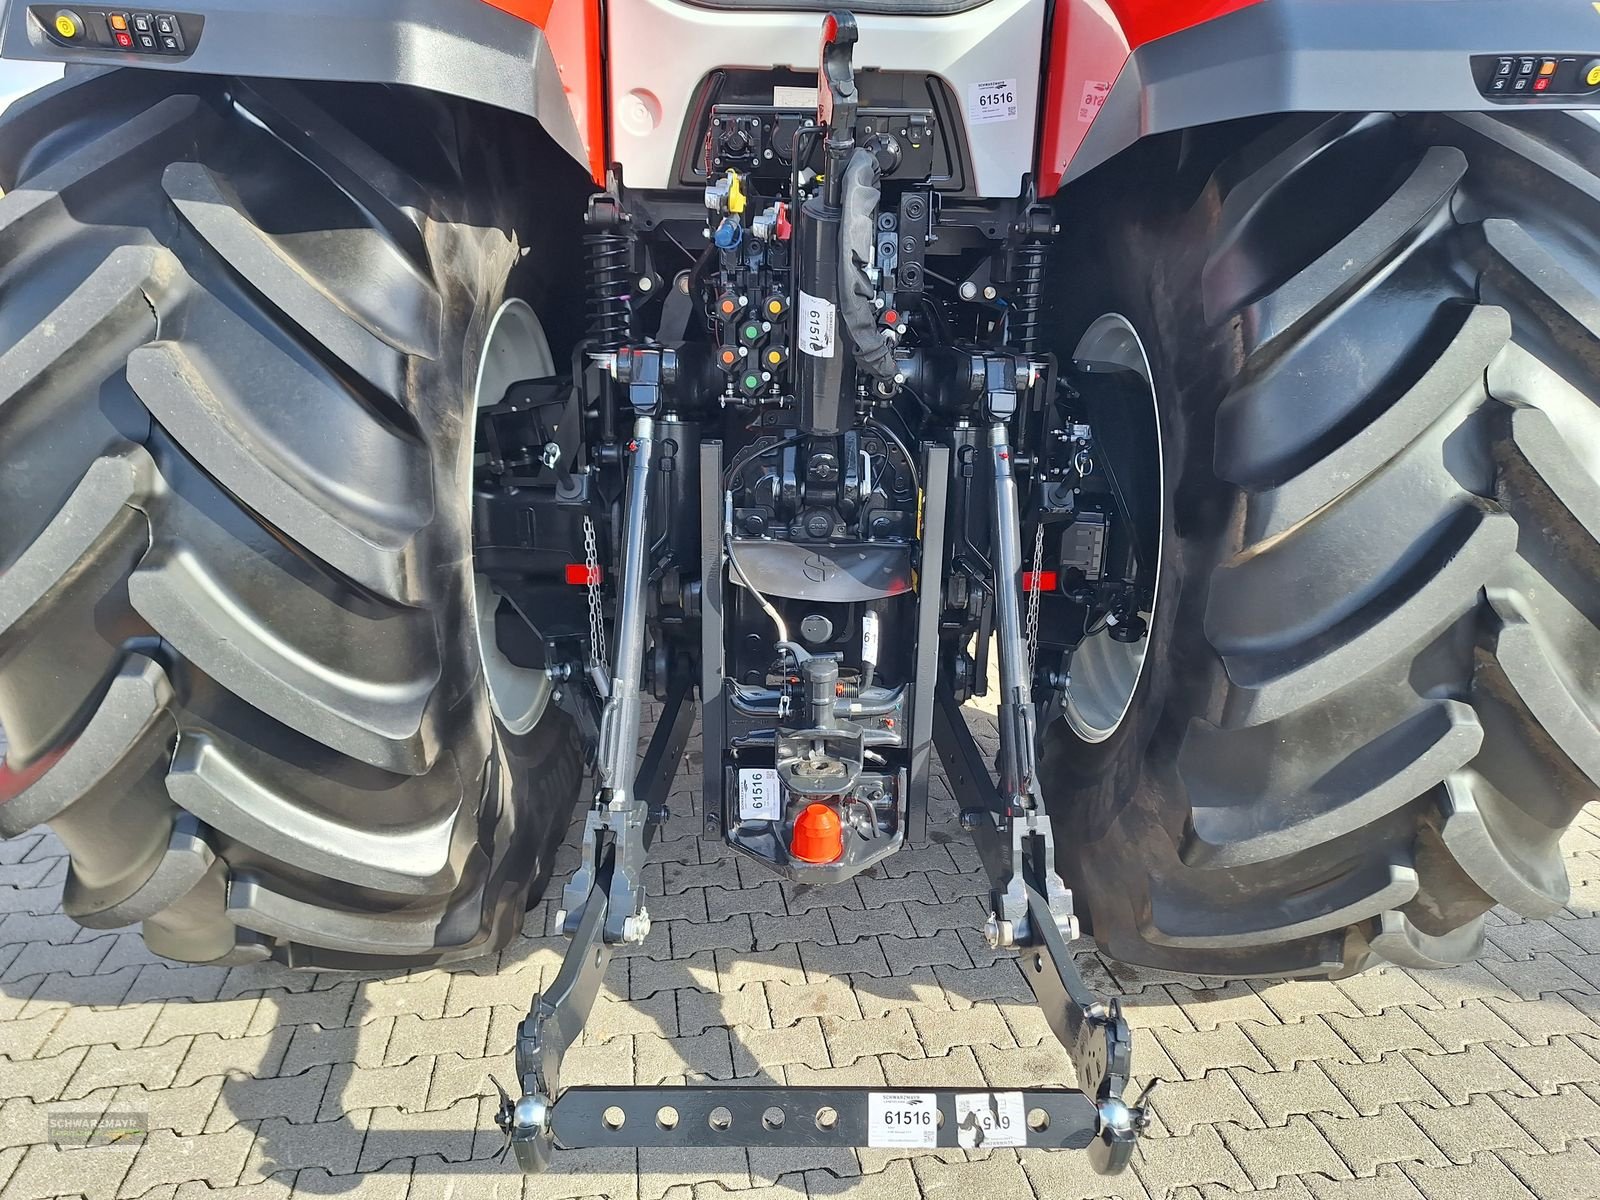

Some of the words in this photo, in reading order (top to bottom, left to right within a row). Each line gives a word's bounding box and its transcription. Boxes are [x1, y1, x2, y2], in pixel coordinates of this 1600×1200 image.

[979, 92, 1013, 106] 61516
[752, 773, 762, 808] 61516
[885, 1111, 931, 1125] 61516
